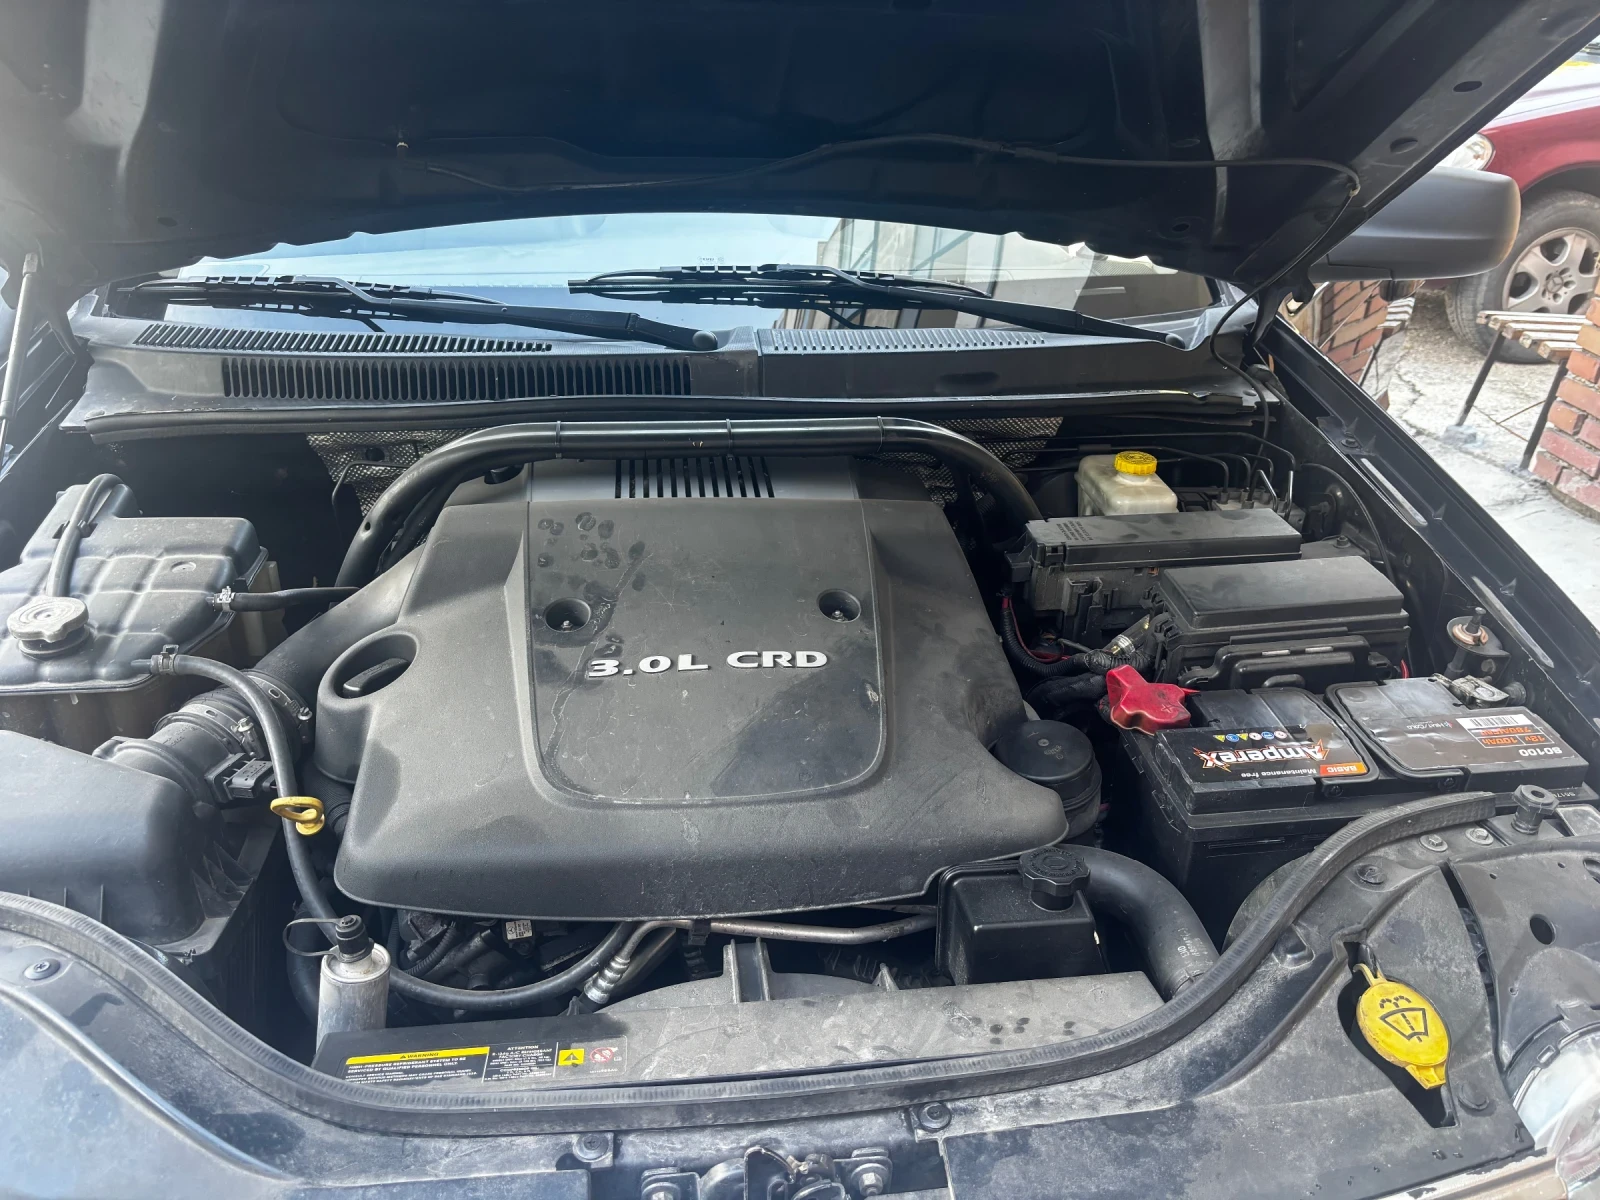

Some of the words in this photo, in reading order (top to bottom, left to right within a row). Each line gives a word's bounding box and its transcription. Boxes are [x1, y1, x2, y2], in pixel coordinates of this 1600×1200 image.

[588, 653, 709, 677] 3.0L
[726, 650, 828, 668] CRD
[1482, 736, 1518, 745] 100Ah
[1326, 764, 1358, 773] BASIC
